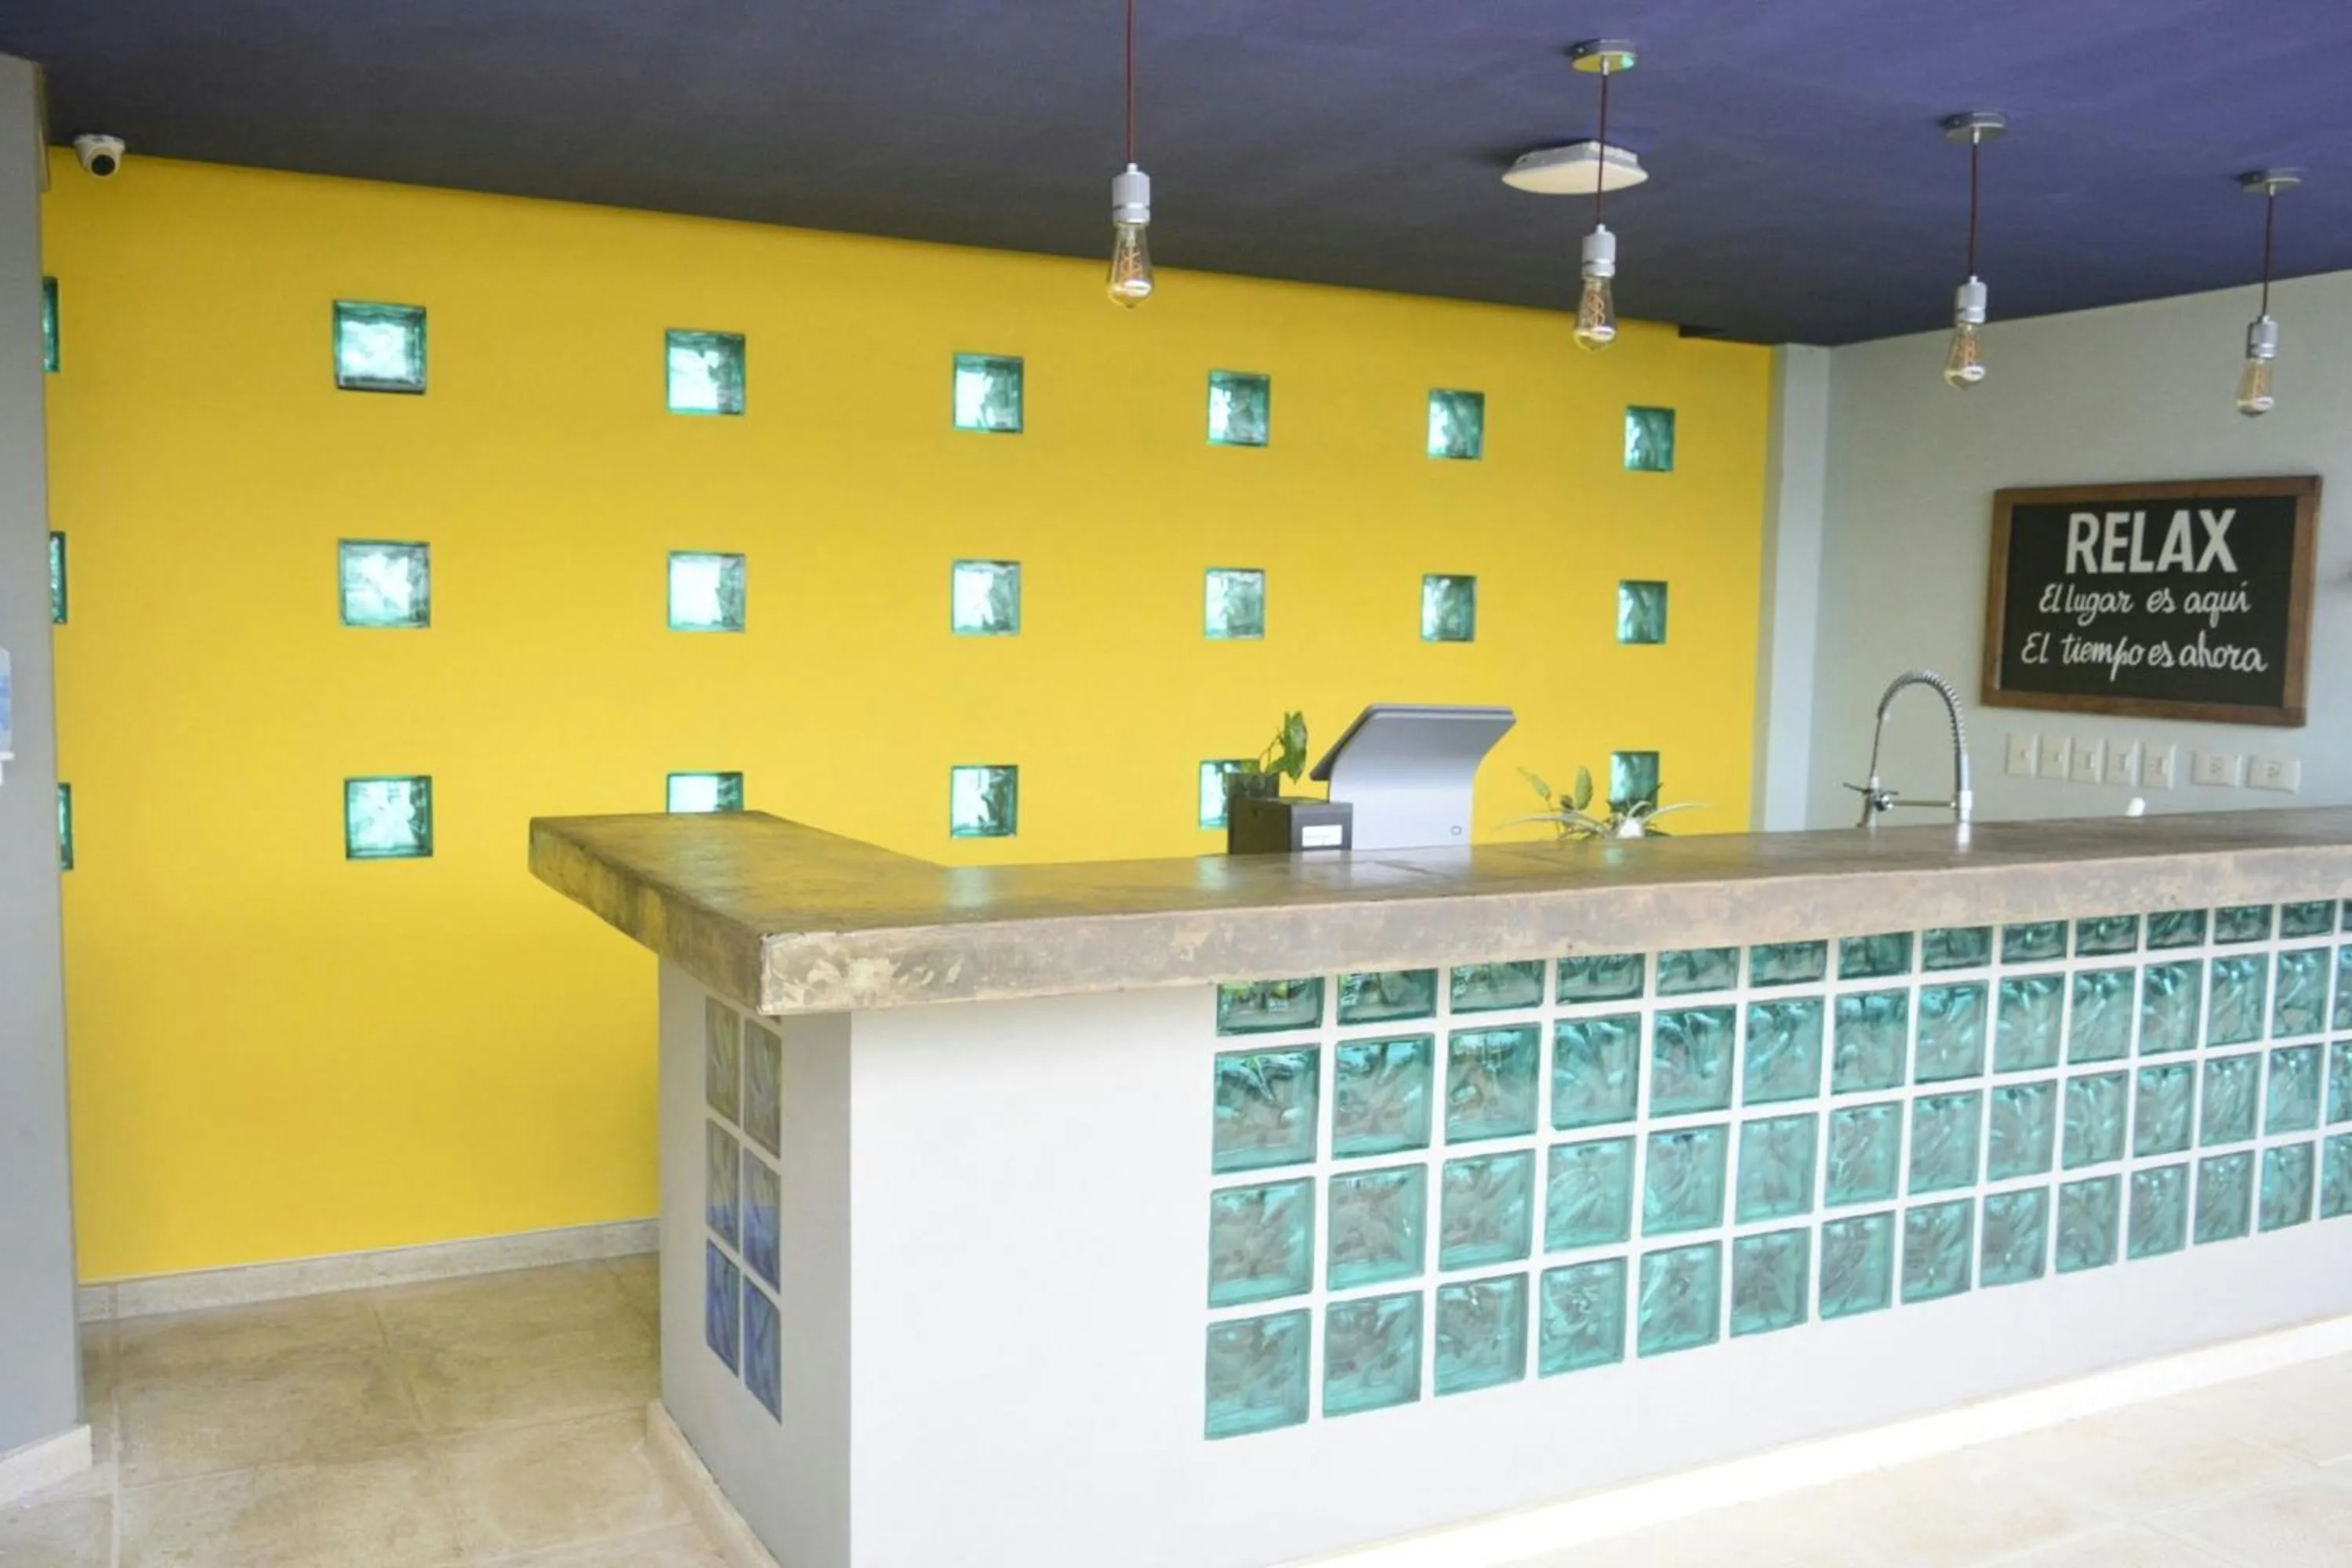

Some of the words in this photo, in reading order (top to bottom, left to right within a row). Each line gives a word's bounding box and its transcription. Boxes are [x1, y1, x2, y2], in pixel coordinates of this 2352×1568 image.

[2065, 509, 2238, 574] RELAX
[2039, 583, 2063, 613] El
[2064, 583, 2134, 626] lugar
[2147, 587, 2176, 613] es
[2183, 581, 2252, 628] aquí
[2021, 632, 2049, 664] El
[2061, 633, 2147, 681] tiempo
[2148, 640, 2174, 666] es
[2180, 630, 2269, 672] ahora
